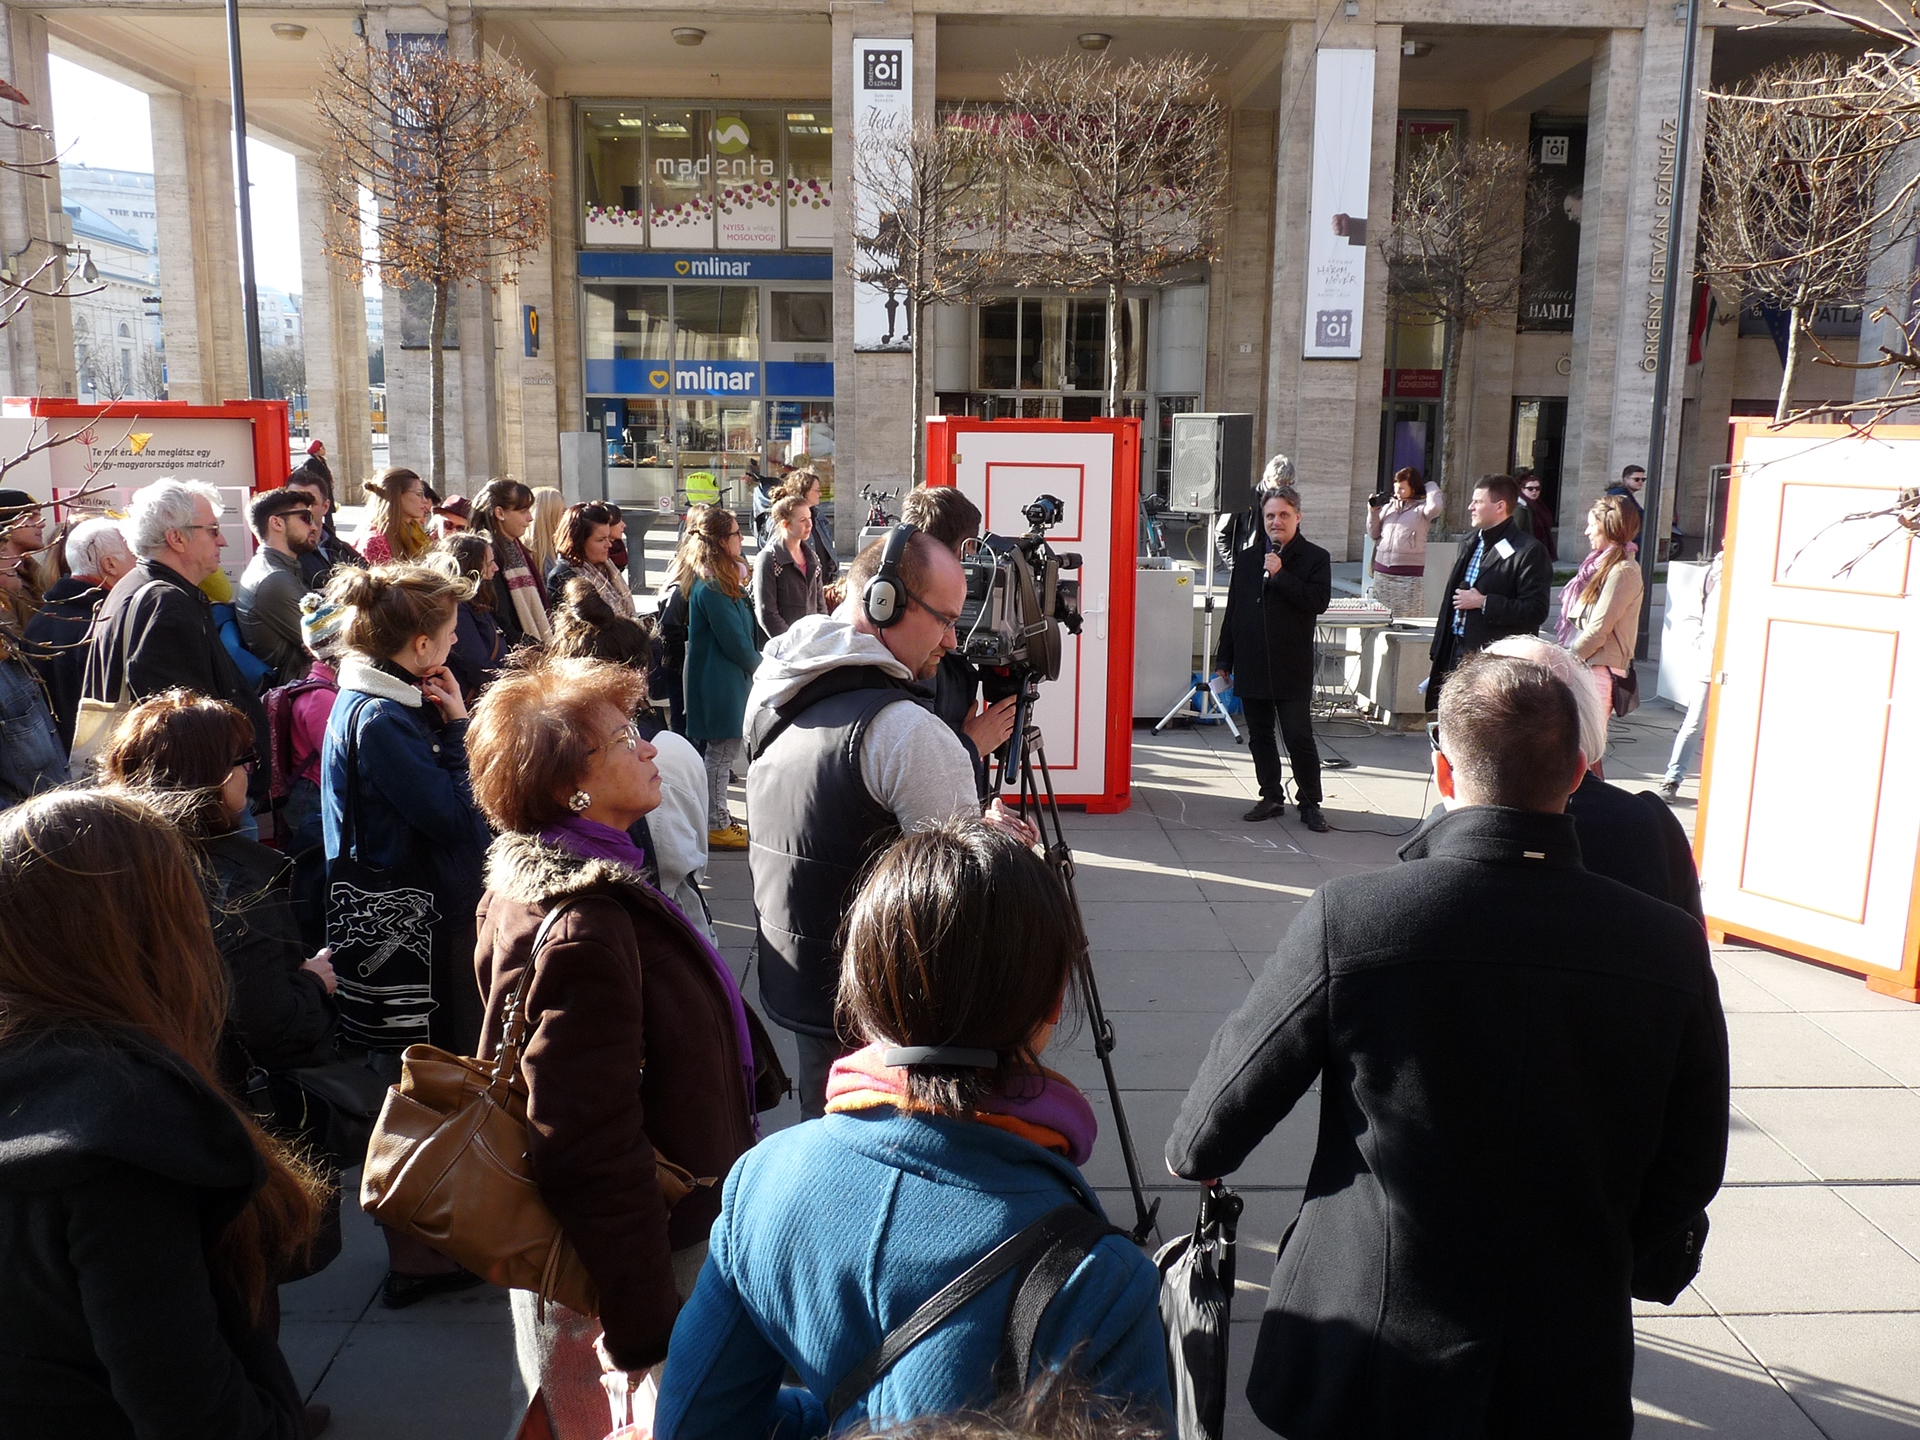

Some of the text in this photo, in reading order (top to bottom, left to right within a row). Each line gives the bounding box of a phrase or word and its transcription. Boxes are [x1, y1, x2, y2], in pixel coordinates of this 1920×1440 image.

[656, 154, 774, 175] madenta
[108, 208, 155, 219] THE RITZ
[723, 223, 745, 231] NYISS
[726, 233, 776, 242] MOSOLYOGJ!
[1639, 118, 1678, 372] ÖRKÉNY ISTVÁN SZÍNHÁZ
[692, 256, 751, 276] mlinar
[676, 366, 755, 390] mlinar
[92, 448, 102, 456] Te
[145, 448, 156, 456] ha
[158, 448, 195, 458] meglátsz
[197, 450, 211, 458] egy
[186, 460, 225, 469] matricát?
